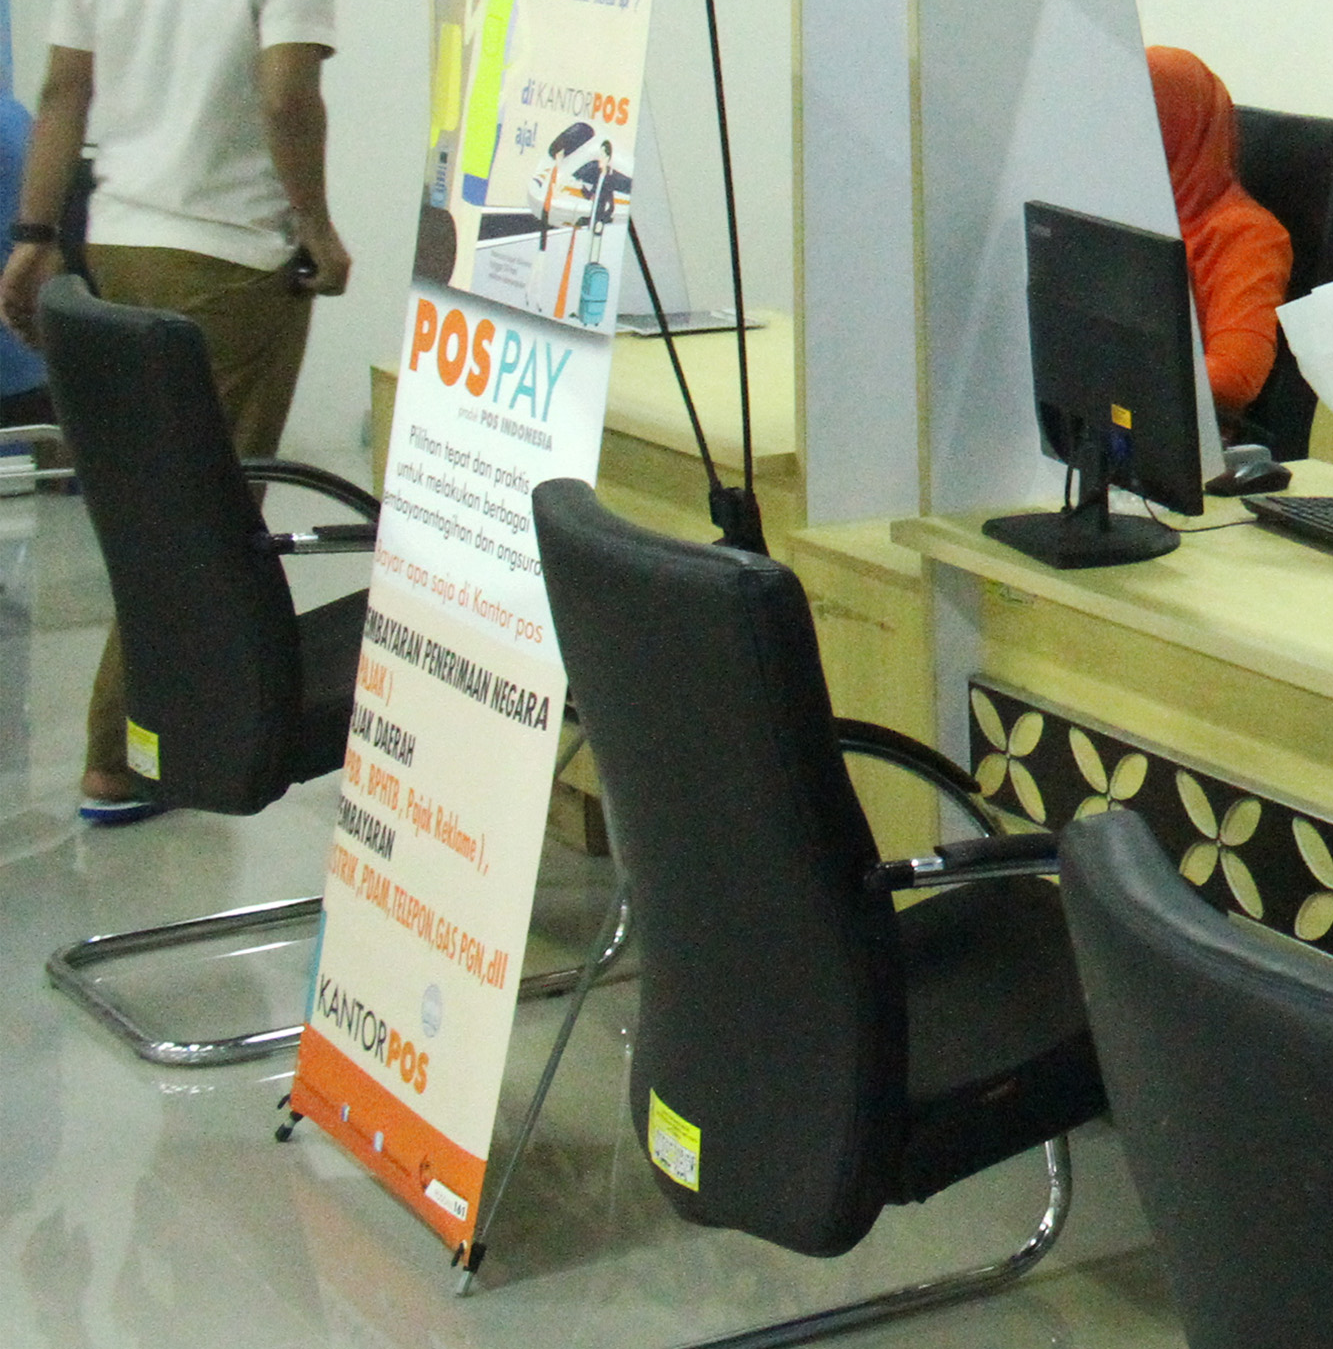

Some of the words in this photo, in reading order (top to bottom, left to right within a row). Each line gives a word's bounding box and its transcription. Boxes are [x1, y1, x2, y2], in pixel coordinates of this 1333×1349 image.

[521, 79, 535, 105] di
[536, 82, 630, 126] KANTORPOS
[515, 120, 538, 155] aja!
[480, 409, 499, 430] POS
[500, 417, 552, 452] INDONESIA
[409, 424, 442, 456] Pilihan
[444, 441, 471, 469] tepat
[472, 451, 492, 479] dan
[495, 466, 530, 497] praktis
[397, 460, 424, 488] untuk
[425, 472, 481, 511] melakukan
[482, 494, 530, 535] berbagai
[474, 525, 495, 555] dan
[407, 563, 429, 589] apa
[430, 570, 455, 603] saja
[457, 581, 470, 609] di
[471, 586, 513, 628] Kantor
[514, 615, 543, 645] pos
[421, 638, 493, 705] PENERIMAAN
[490, 675, 550, 732] NEGARA
[373, 716, 416, 768] DAERAH
[434, 804, 477, 863] Reklame
[317, 973, 430, 1095] KANTORPOS
